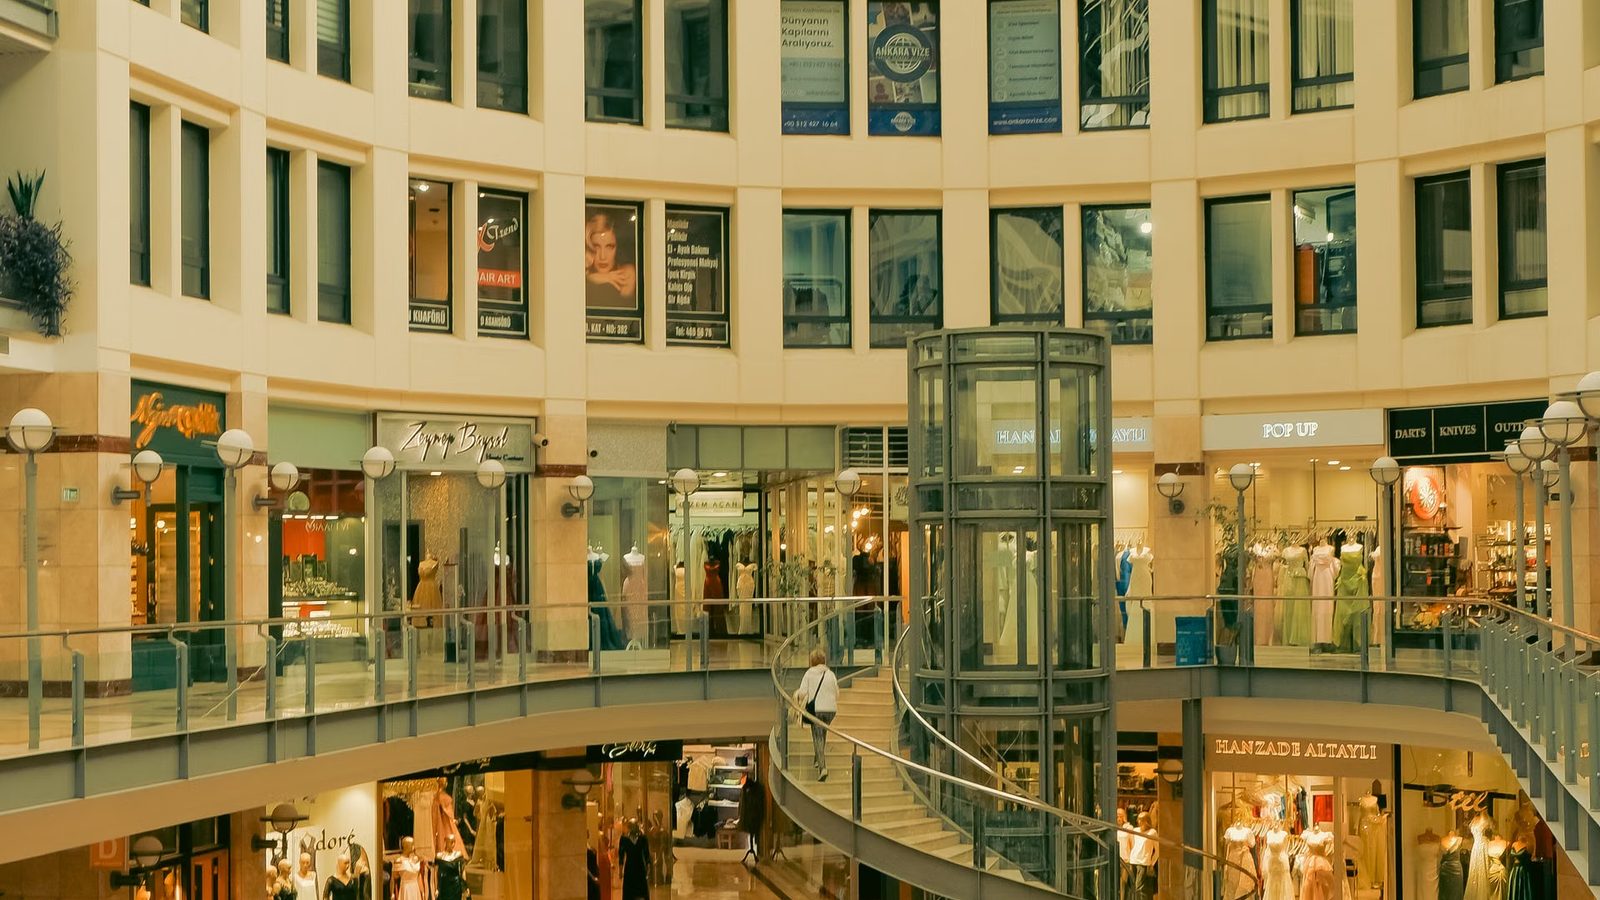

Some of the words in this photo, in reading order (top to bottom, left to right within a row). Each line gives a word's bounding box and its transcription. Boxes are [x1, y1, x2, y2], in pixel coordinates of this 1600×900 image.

[781, 16, 829, 27] Dünyanın
[781, 28, 829, 38] Kapılarını
[781, 39, 834, 50] Aralıyoruz.
[875, 46, 910, 57] ANKARA
[477, 270, 496, 283] AIR
[497, 273, 517, 286] ART
[412, 308, 446, 324] KUAFÖRÜ
[590, 322, 601, 334] KAT
[1263, 423, 1294, 438] POP
[1296, 422, 1319, 437] UP
[1394, 427, 1427, 439] DARTS
[1439, 424, 1477, 437] KNIVES
[1494, 421, 1526, 433] OUTD
[1215, 738, 1301, 757] HANZADE
[1304, 742, 1377, 760] ALTAYLI
